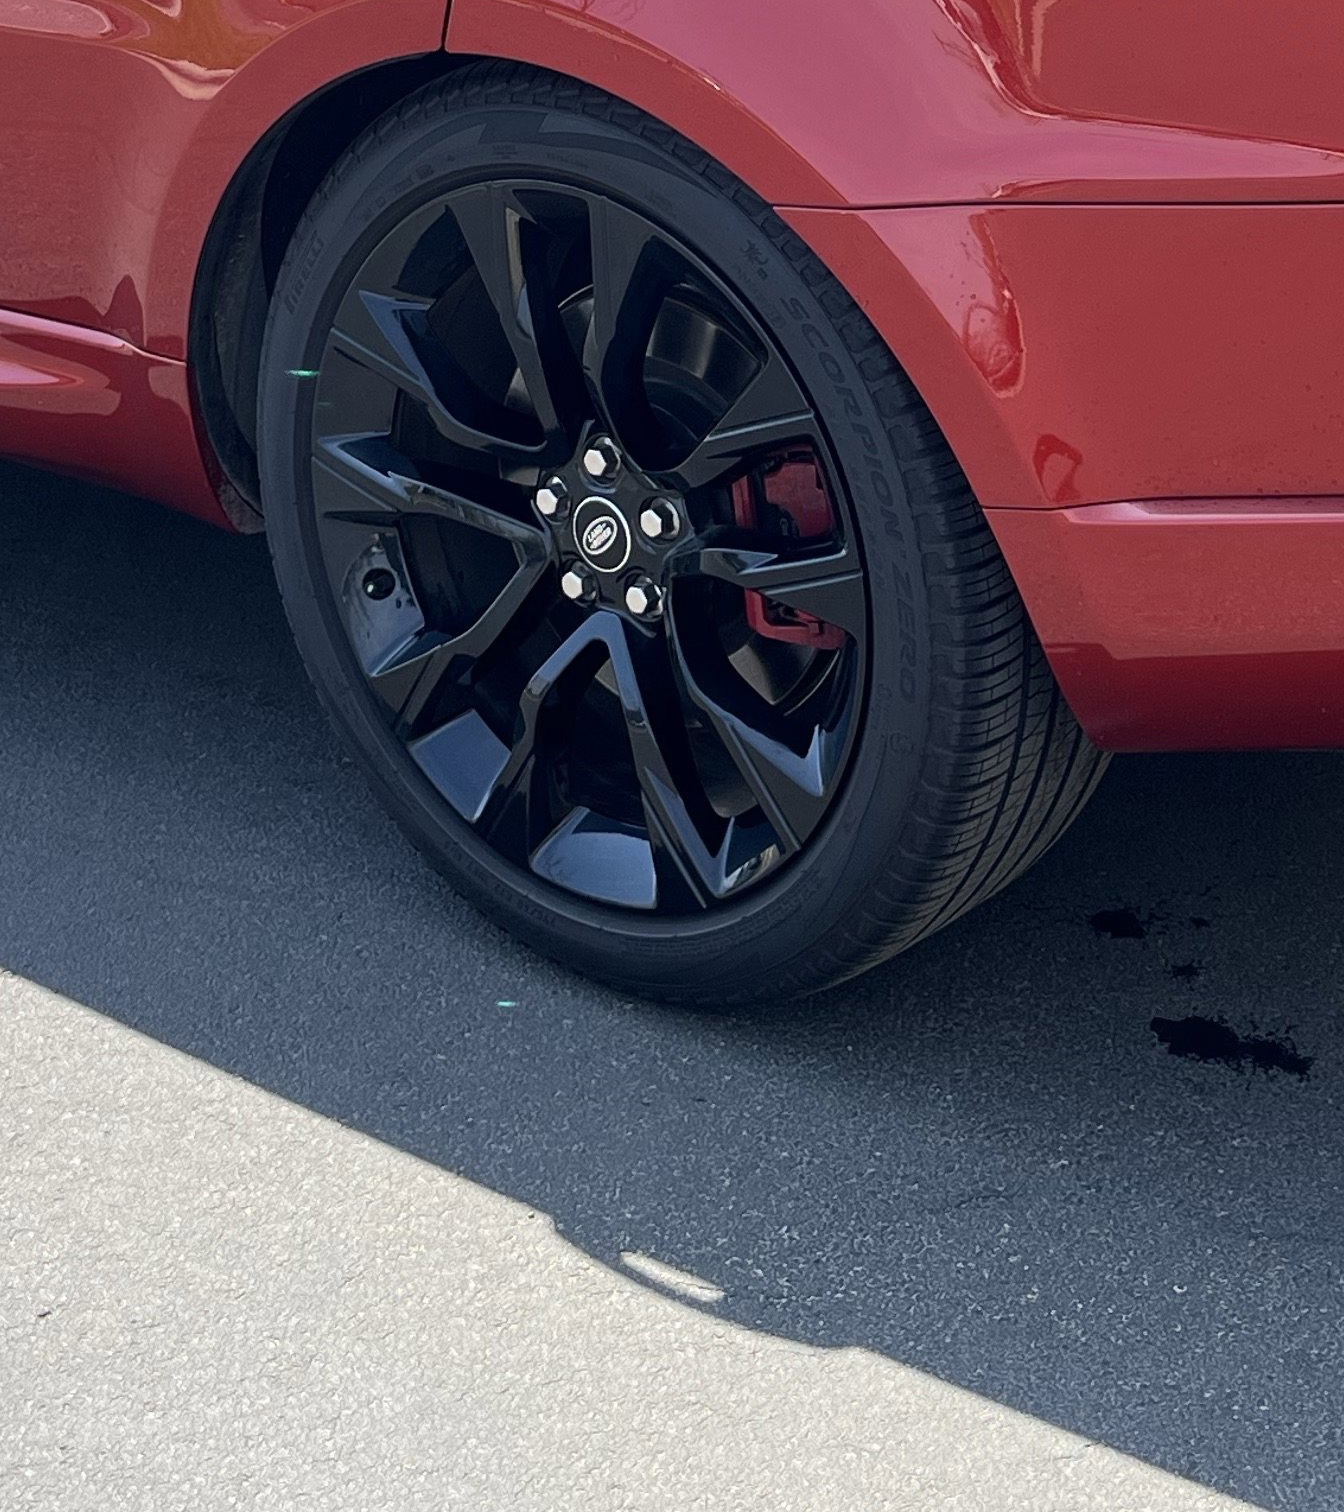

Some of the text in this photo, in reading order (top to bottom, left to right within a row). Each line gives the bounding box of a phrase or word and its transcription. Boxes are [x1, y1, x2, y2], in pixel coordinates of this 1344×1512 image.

[283, 229, 324, 316] PIRELLI
[778, 296, 904, 543] SCORPION
[890, 562, 917, 704] ZERO
